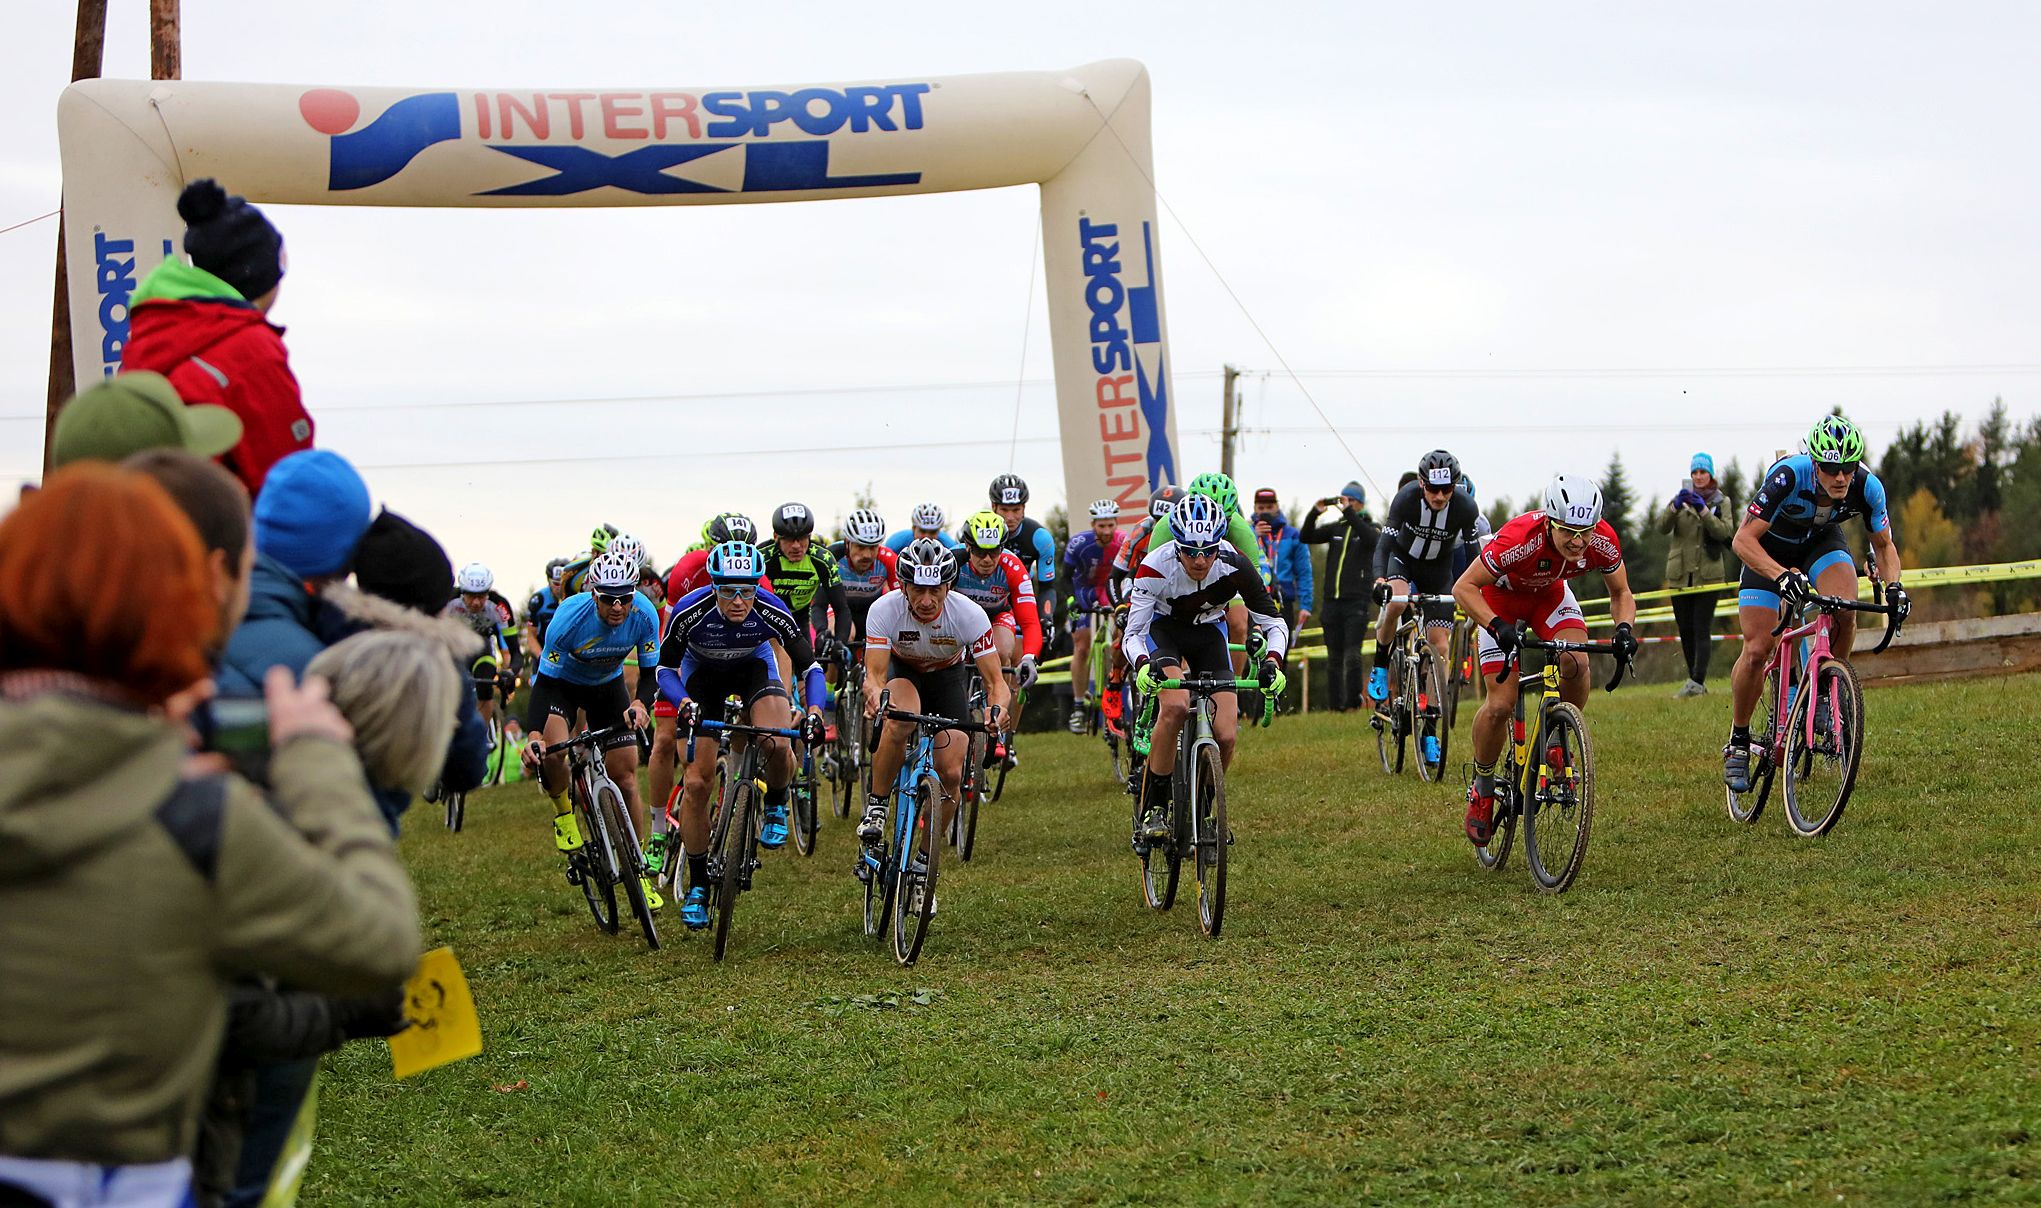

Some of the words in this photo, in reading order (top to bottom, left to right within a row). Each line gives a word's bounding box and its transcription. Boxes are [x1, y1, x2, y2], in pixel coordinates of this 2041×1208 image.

[474, 83, 930, 141] INTERSPORT
[470, 139, 922, 196] XL
[94, 232, 136, 382] PORT
[1078, 217, 1149, 526] INTERSPORT
[1823, 451, 1839, 461] 106
[1431, 469, 1449, 479] 112
[1005, 490, 1017, 499] 124
[1155, 503, 1170, 512] 142
[1569, 505, 1593, 519] 107
[1187, 521, 1212, 534] 104
[980, 529, 999, 539] 120
[727, 558, 751, 570] 103
[604, 568, 625, 580] 101
[917, 565, 939, 578] 108
